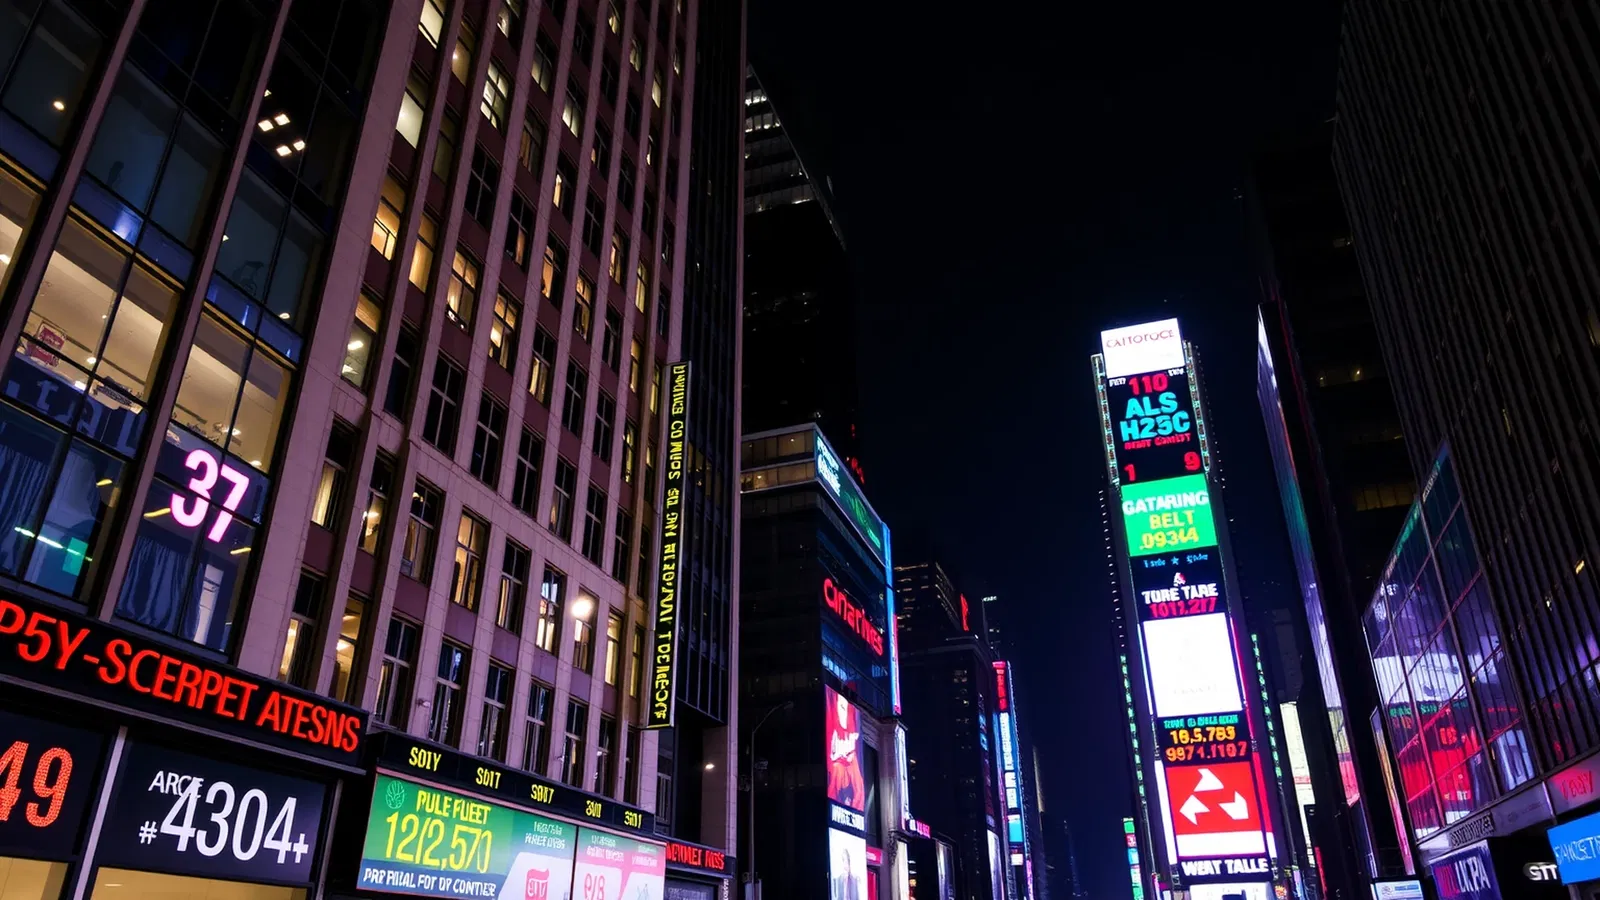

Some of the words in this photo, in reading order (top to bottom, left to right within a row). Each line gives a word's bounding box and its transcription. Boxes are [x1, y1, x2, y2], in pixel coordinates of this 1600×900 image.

[1128, 373, 1168, 395] 110
[1125, 391, 1178, 419] ALS
[1120, 410, 1190, 442] H25C
[1124, 464, 1136, 481] 1
[1184, 452, 1200, 470] 9
[168, 449, 250, 543] 37
[1149, 510, 1195, 530] BELT
[255, 691, 361, 752] ATESNS
